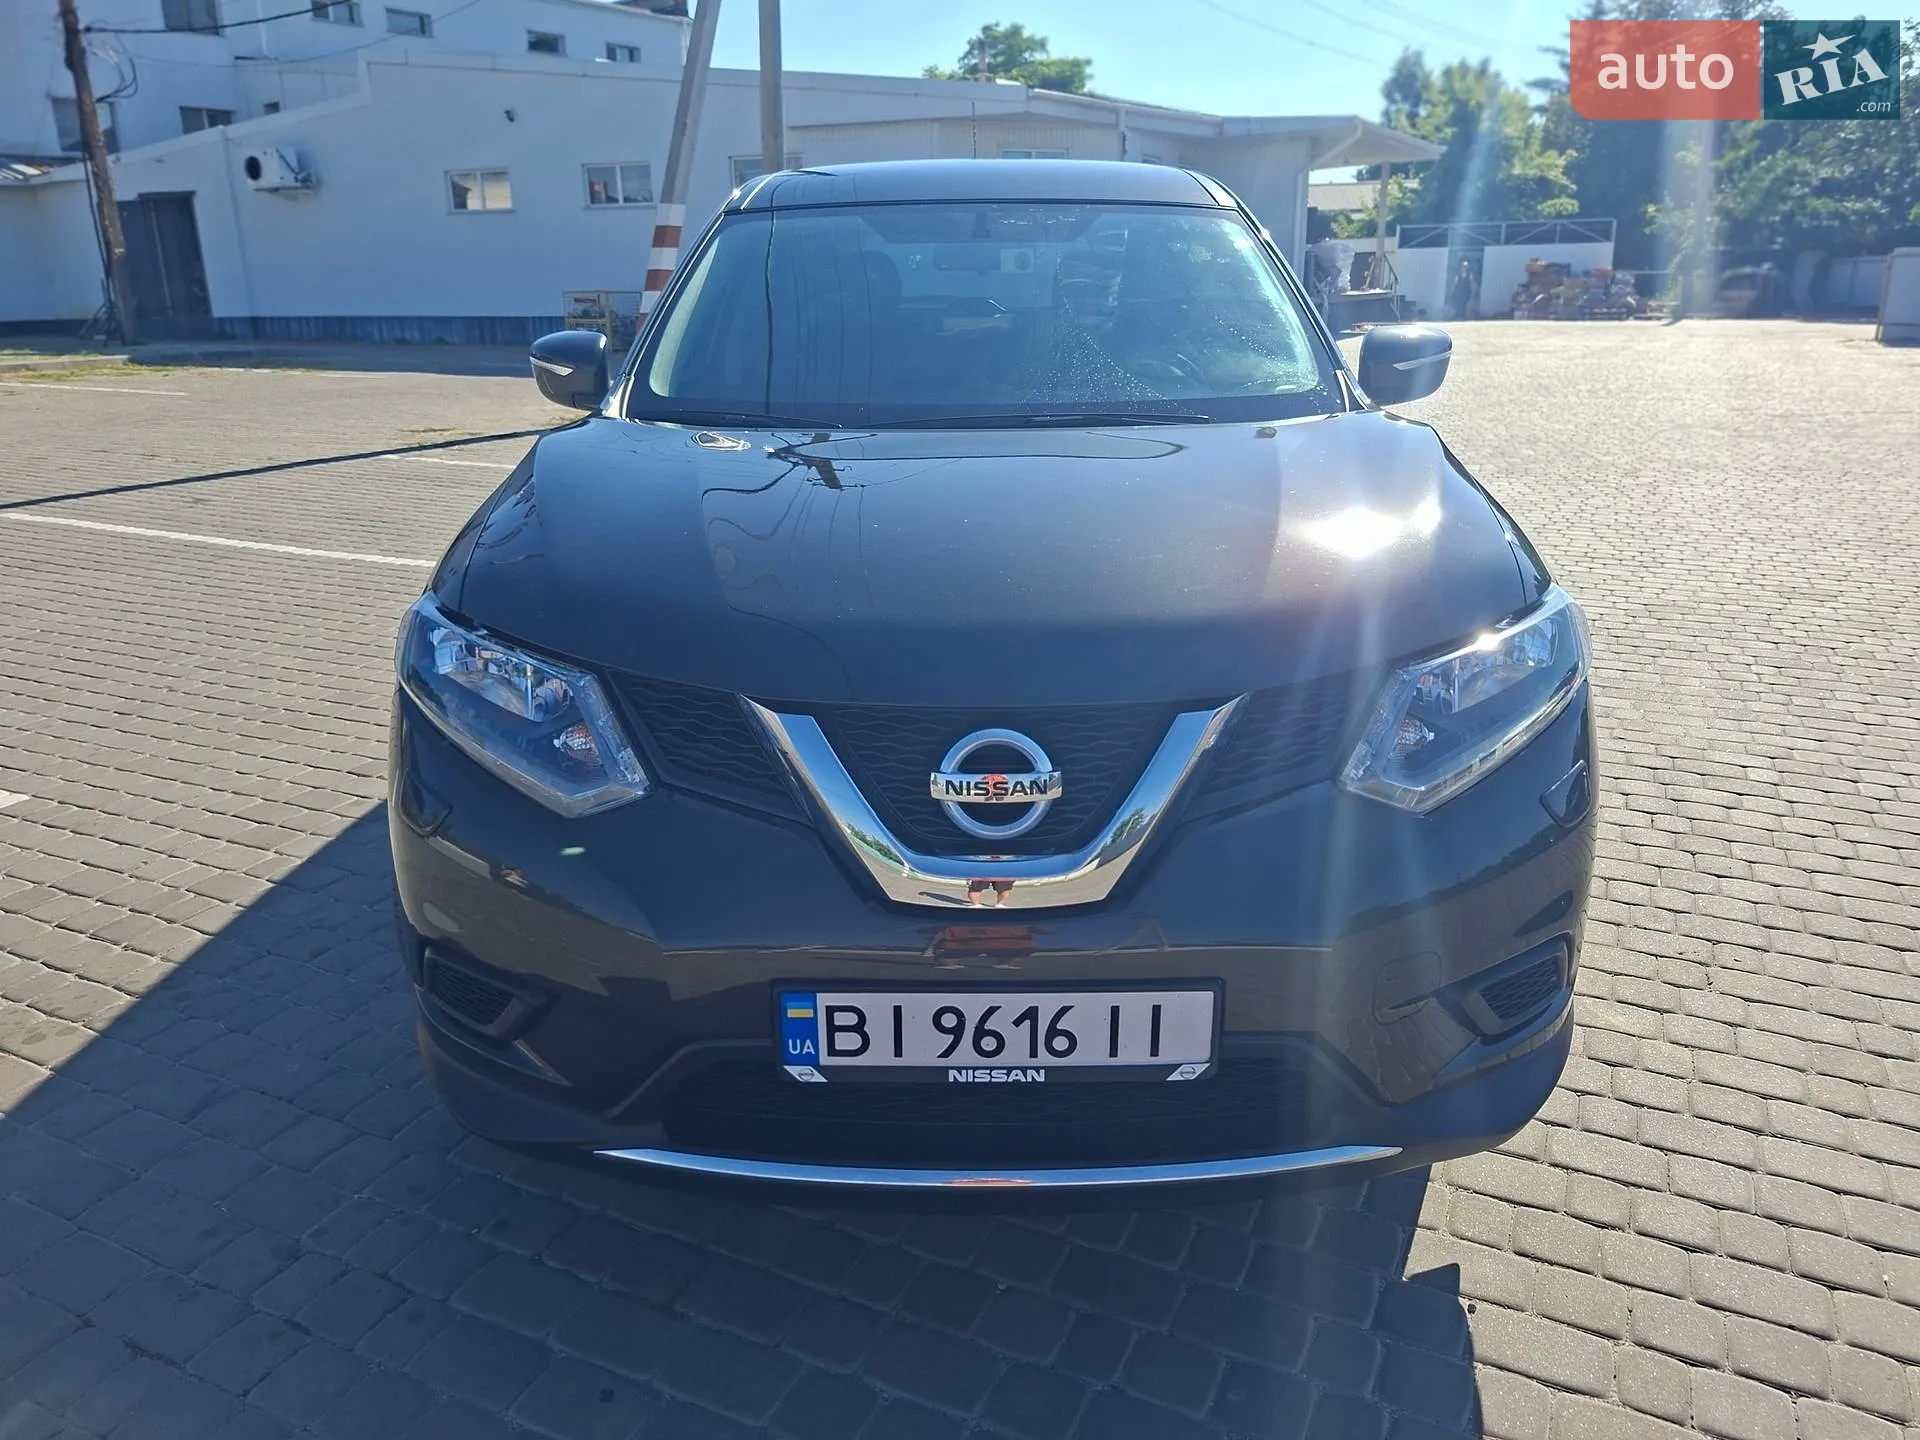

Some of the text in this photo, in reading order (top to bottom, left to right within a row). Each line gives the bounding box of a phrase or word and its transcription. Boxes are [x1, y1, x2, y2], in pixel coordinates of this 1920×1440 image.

[945, 779, 1048, 797] NISSAN
[824, 1004, 1163, 1059] BI 9616 II
[788, 1038, 816, 1055] UA
[948, 1068, 1046, 1083] NISSAN
